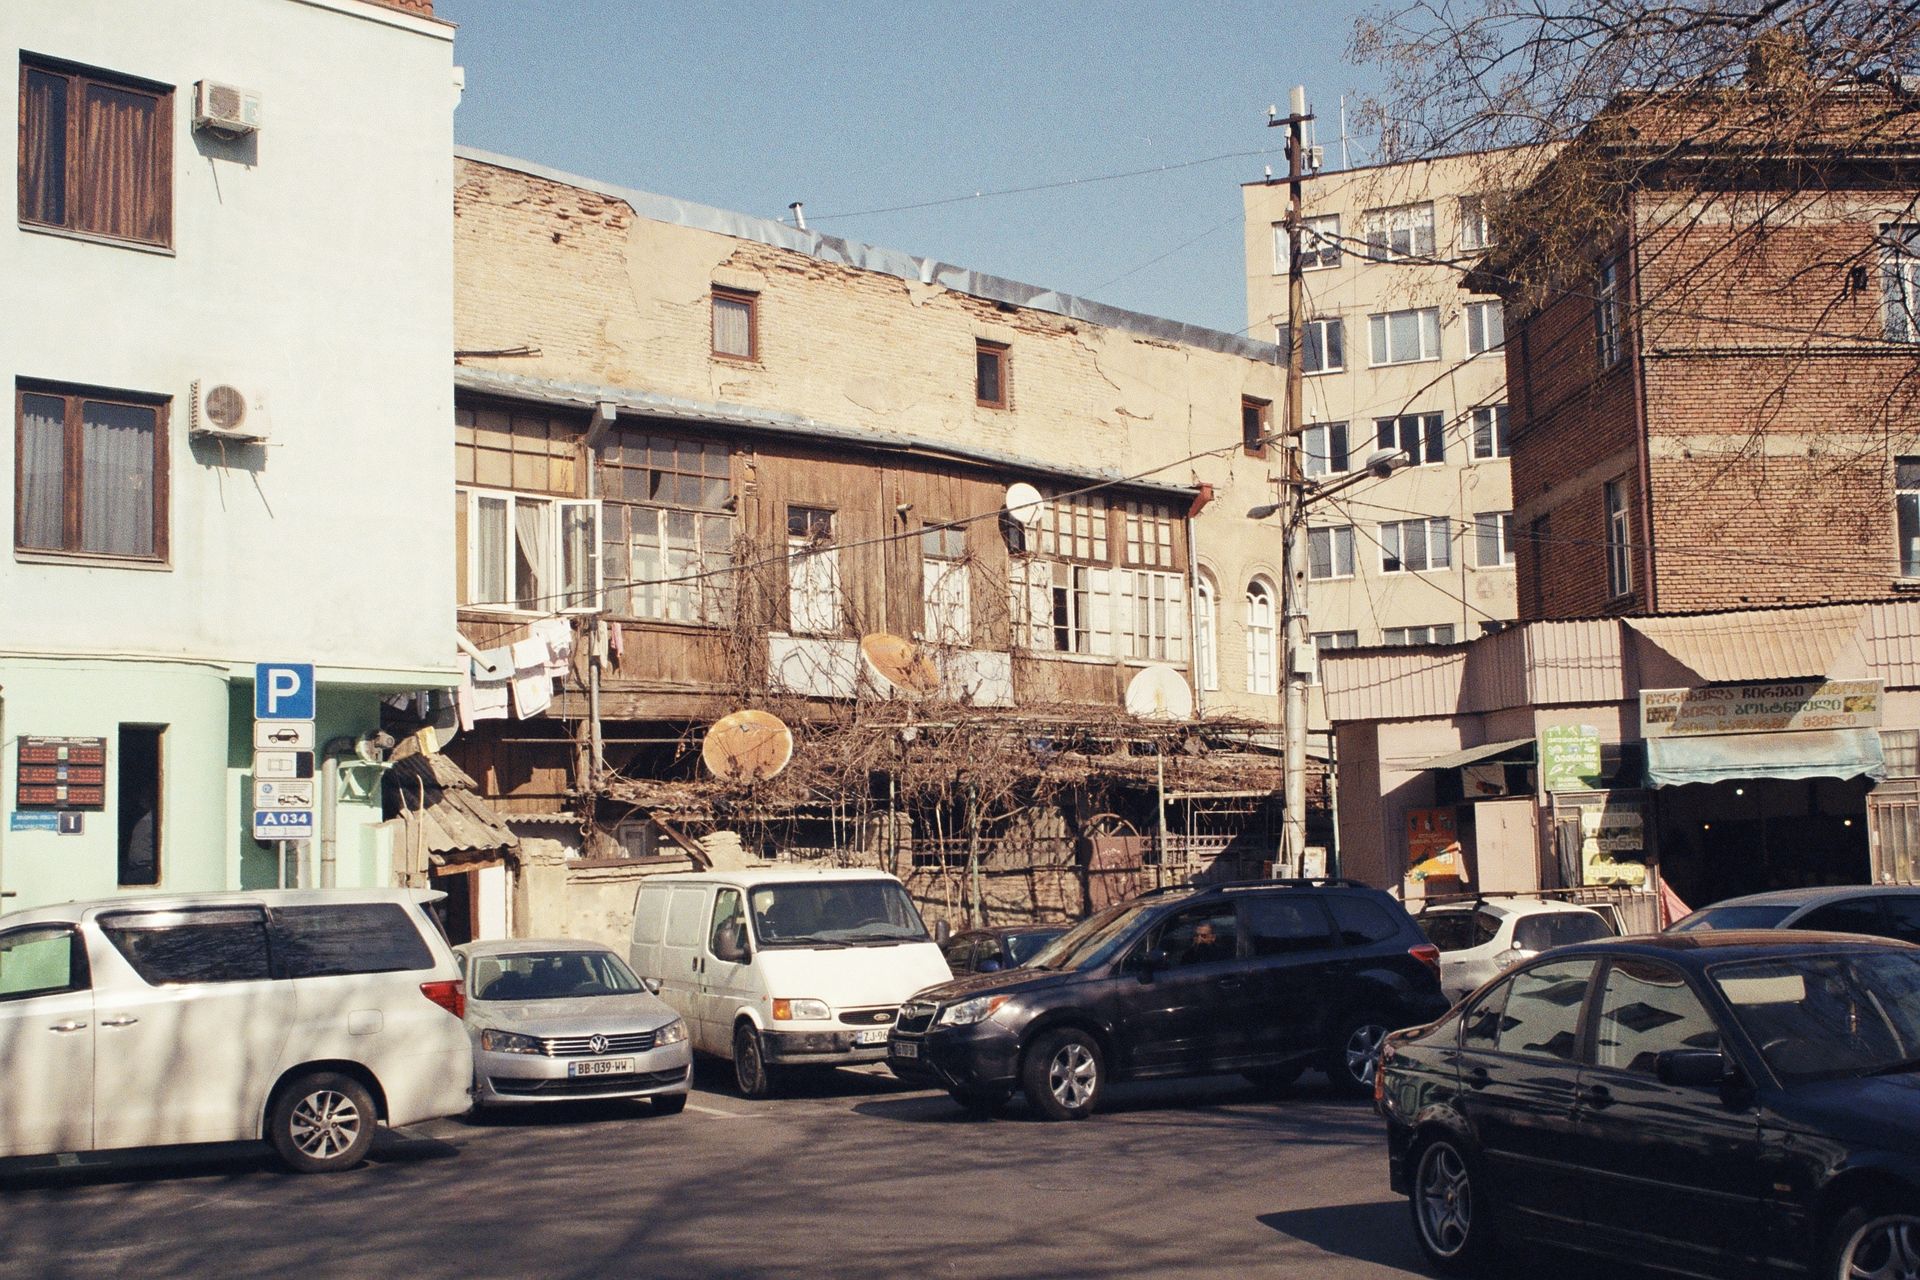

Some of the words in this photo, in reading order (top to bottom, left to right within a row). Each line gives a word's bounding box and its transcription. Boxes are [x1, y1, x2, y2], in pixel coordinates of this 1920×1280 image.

[268, 669, 301, 713] P
[1741, 684, 1805, 699] ჩირები
[263, 812, 278, 825] A
[280, 813, 308, 824] 034
[578, 1060, 627, 1074] BB-039-WW
